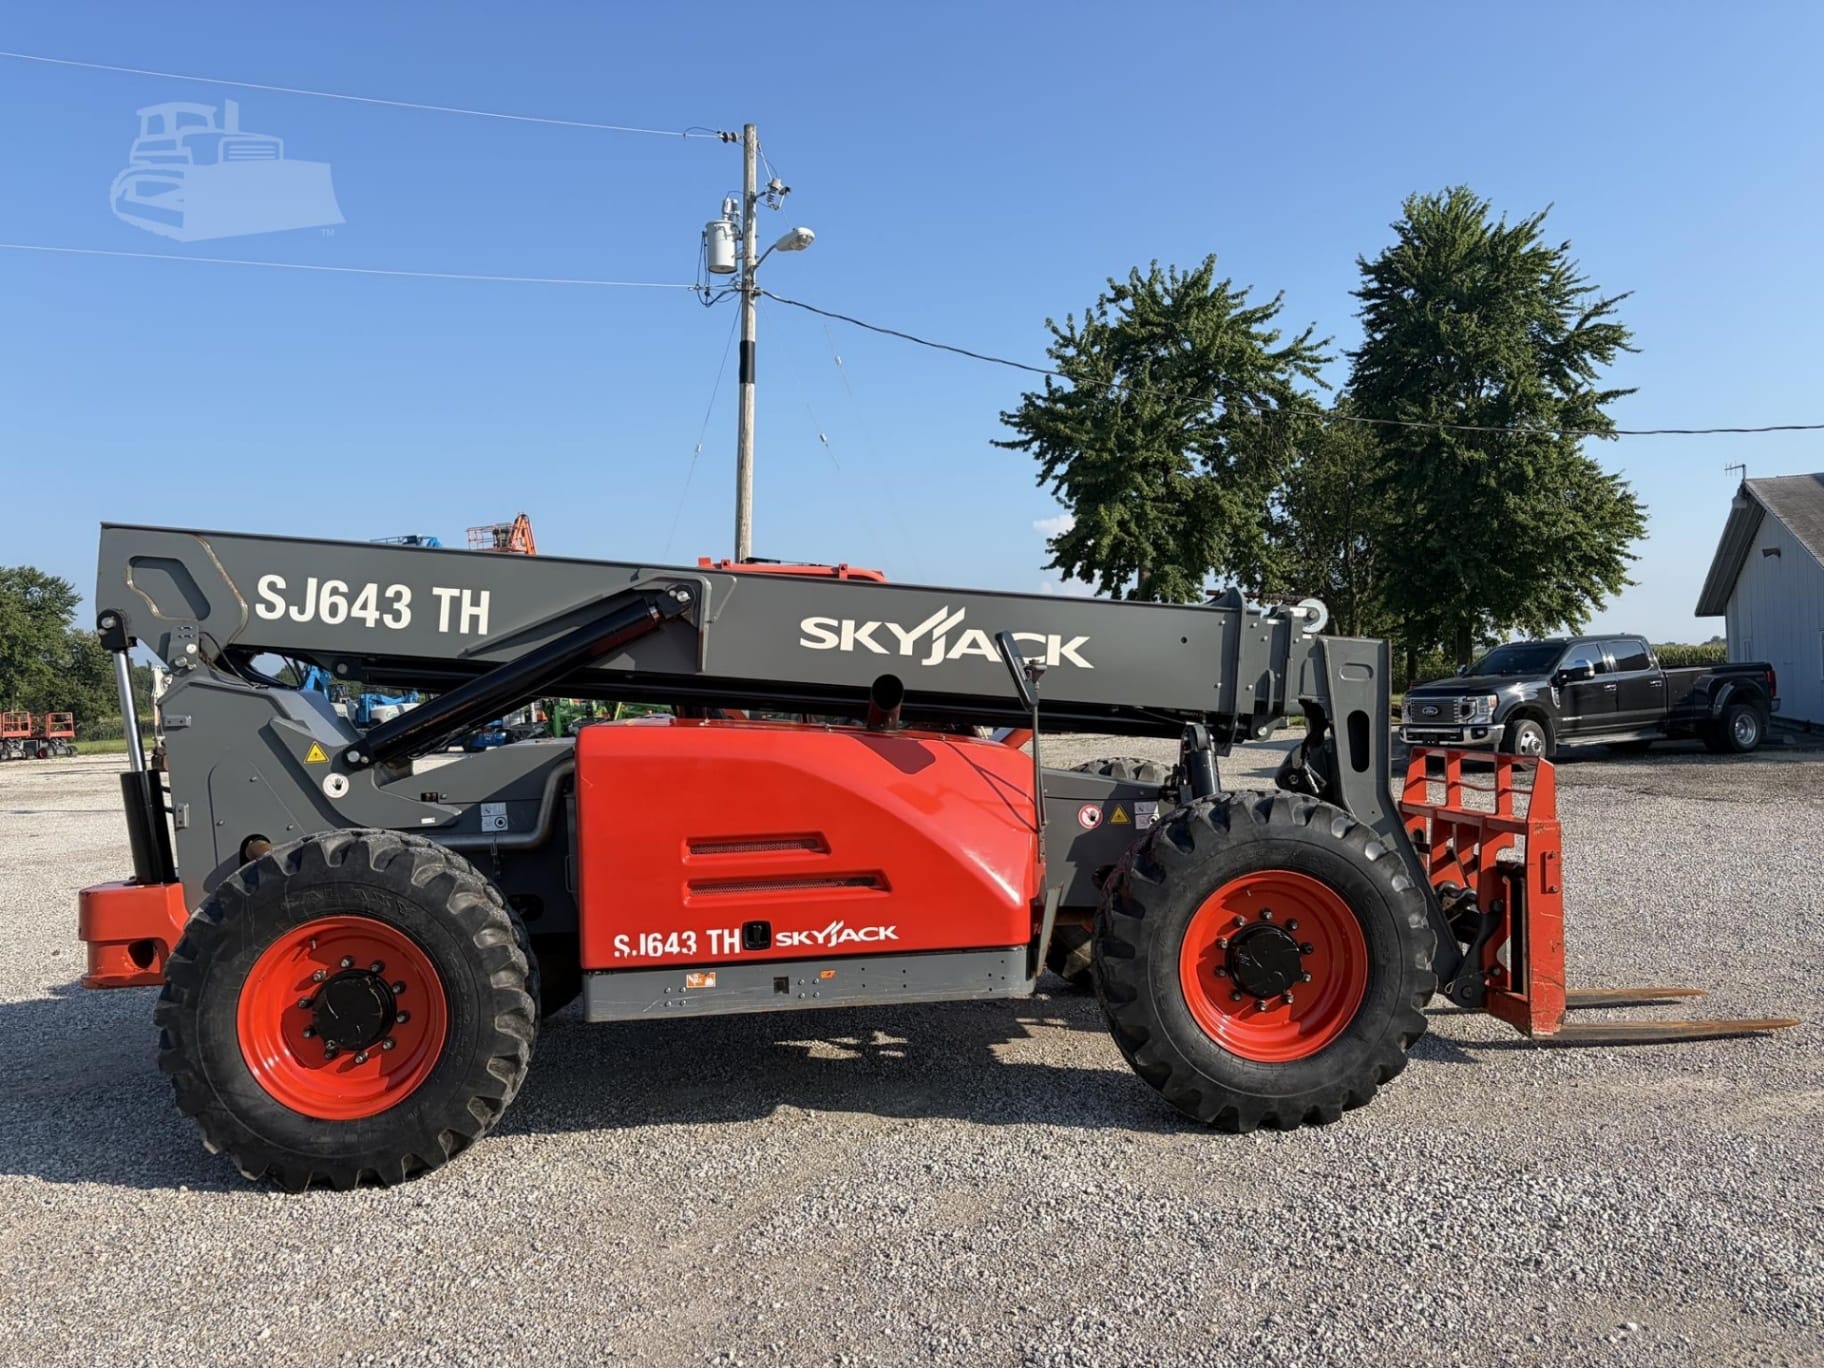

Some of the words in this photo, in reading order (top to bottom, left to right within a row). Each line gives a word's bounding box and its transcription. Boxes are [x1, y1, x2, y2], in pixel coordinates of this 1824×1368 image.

[255, 574, 412, 630] SJ643
[431, 586, 490, 636] TH
[799, 605, 1095, 669] SKYJACK
[706, 928, 741, 955] TH
[775, 921, 899, 948] SKYJACK
